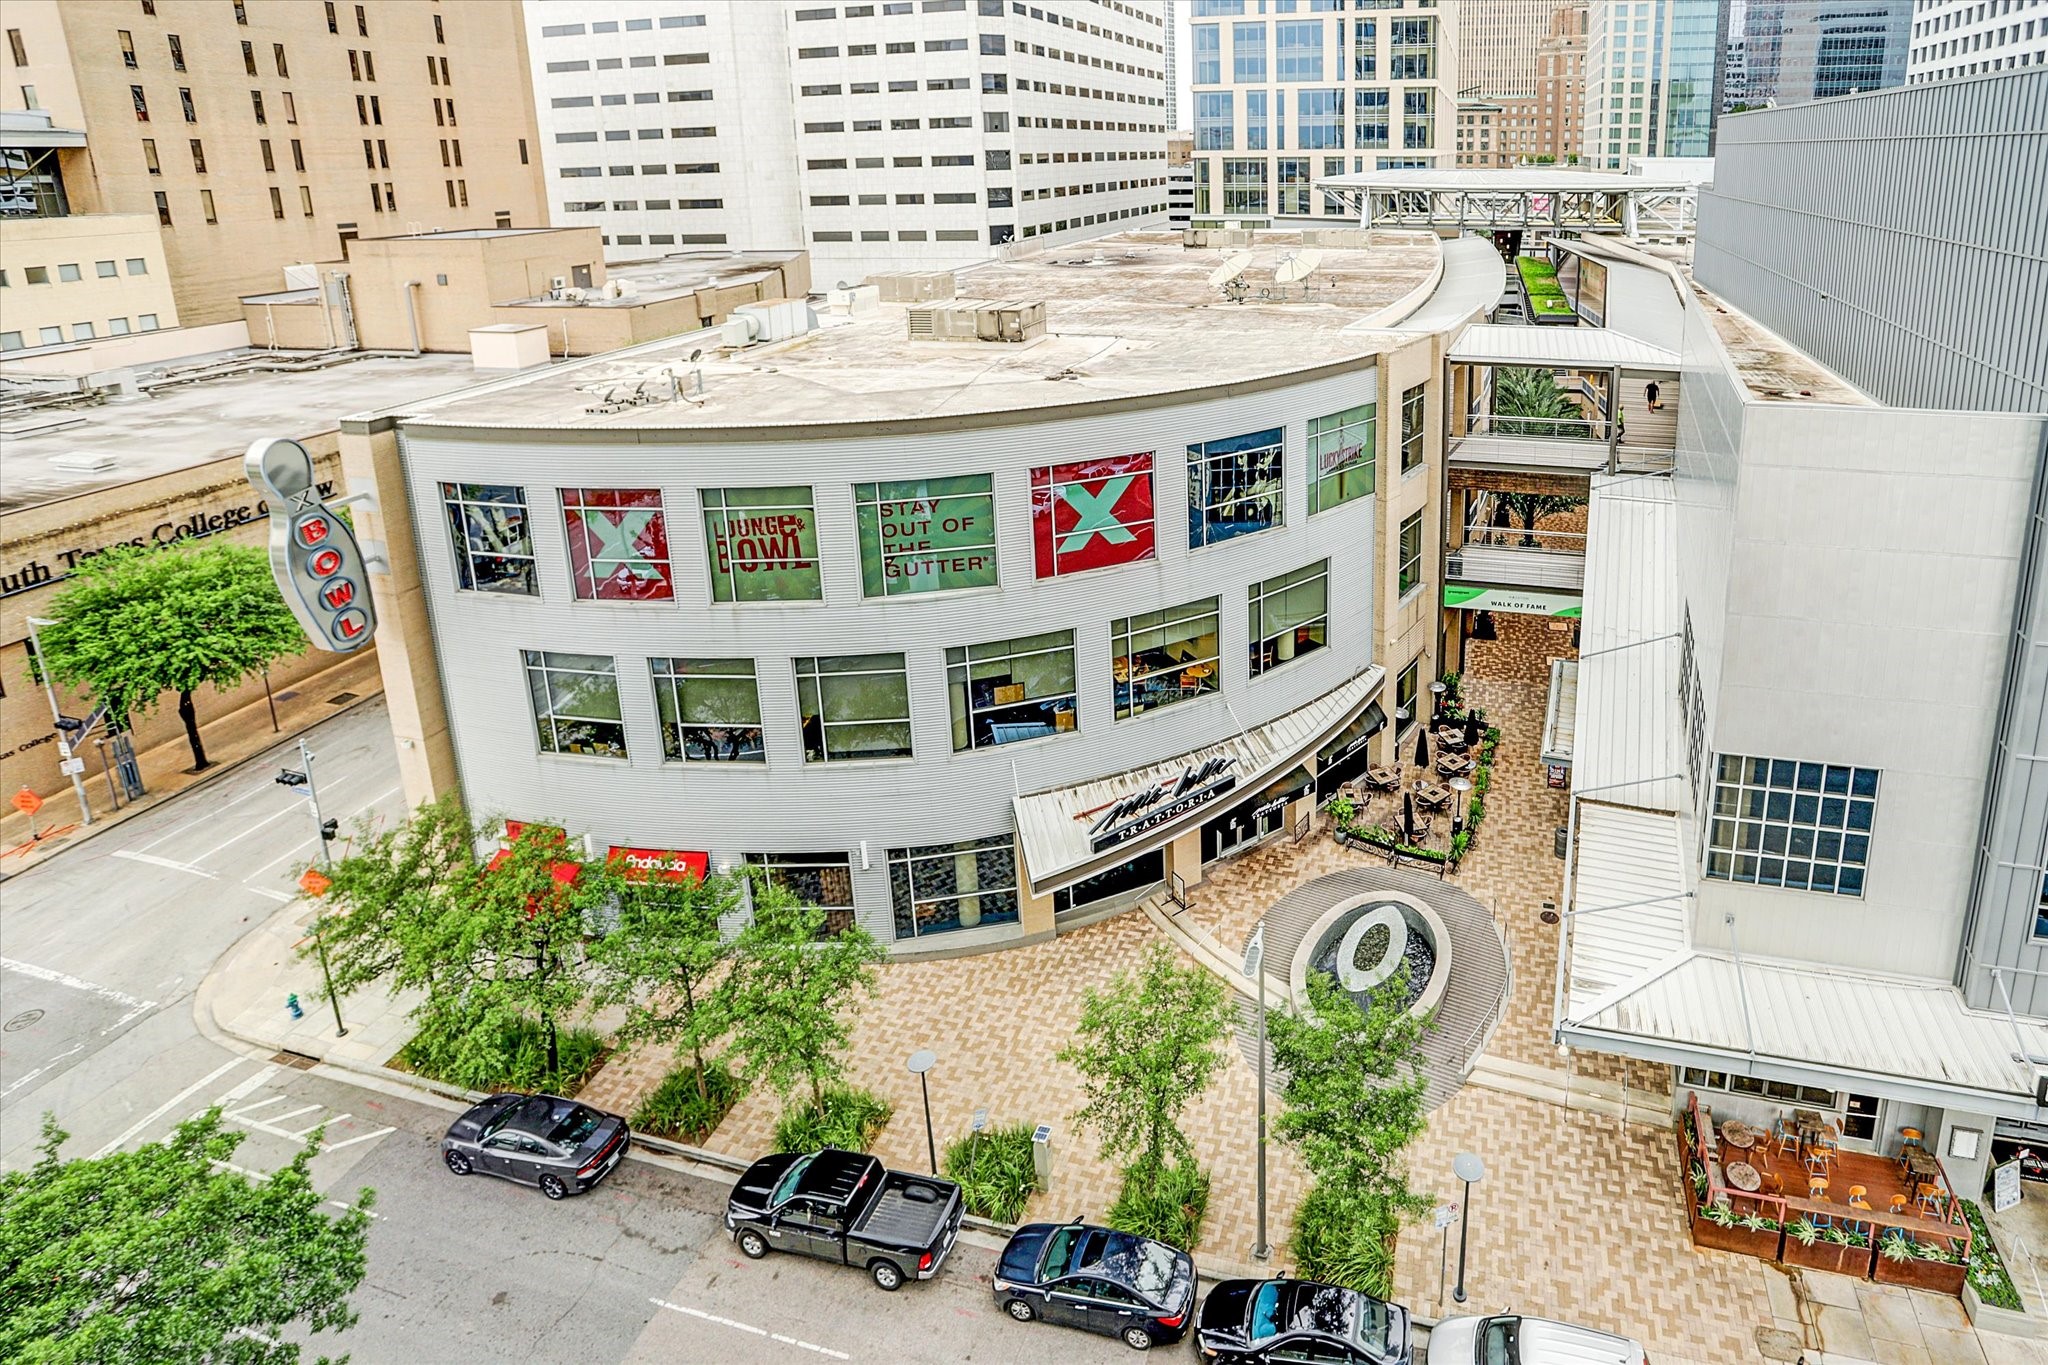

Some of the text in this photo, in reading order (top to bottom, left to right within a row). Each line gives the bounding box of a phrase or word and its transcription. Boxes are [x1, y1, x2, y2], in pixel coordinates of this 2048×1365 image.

[290, 489, 314, 512] X
[880, 499, 941, 518] STAY
[1054, 475, 1138, 554] X
[152, 506, 251, 547] College
[882, 517, 974, 538] OUT OF
[575, 510, 665, 580] X
[716, 536, 812, 574] BOWL
[883, 541, 931, 554] THE
[300, 519, 364, 638] BOWL
[1490, 600, 1512, 608] WALK
[1526, 603, 1547, 611] FAME
